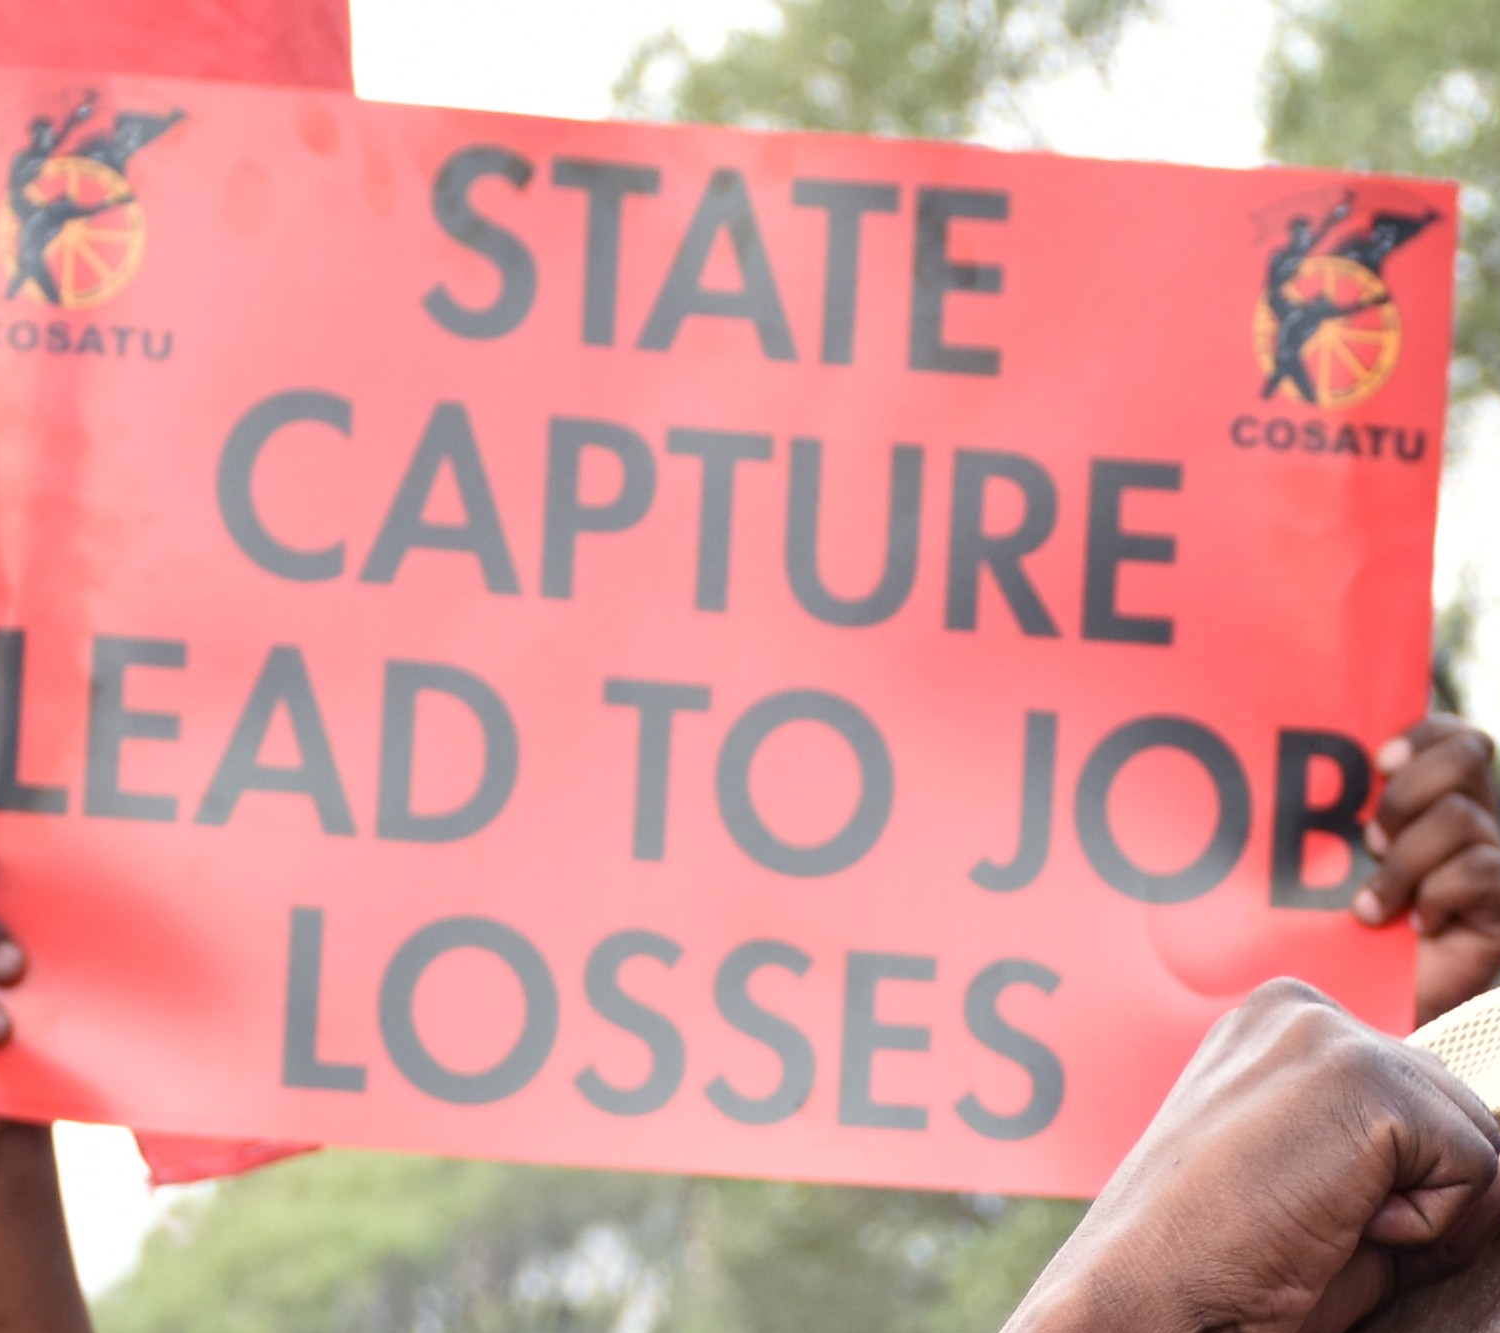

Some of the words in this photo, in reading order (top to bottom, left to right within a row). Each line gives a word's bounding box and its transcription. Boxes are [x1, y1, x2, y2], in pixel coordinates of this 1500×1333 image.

[421, 143, 1013, 378] STATE
[215, 388, 1185, 648] CAPTURE
[1229, 415, 1427, 464] COSATU
[603, 679, 894, 879] TO
[970, 709, 1376, 913] JOB
[280, 906, 1066, 1143] LOSSES
